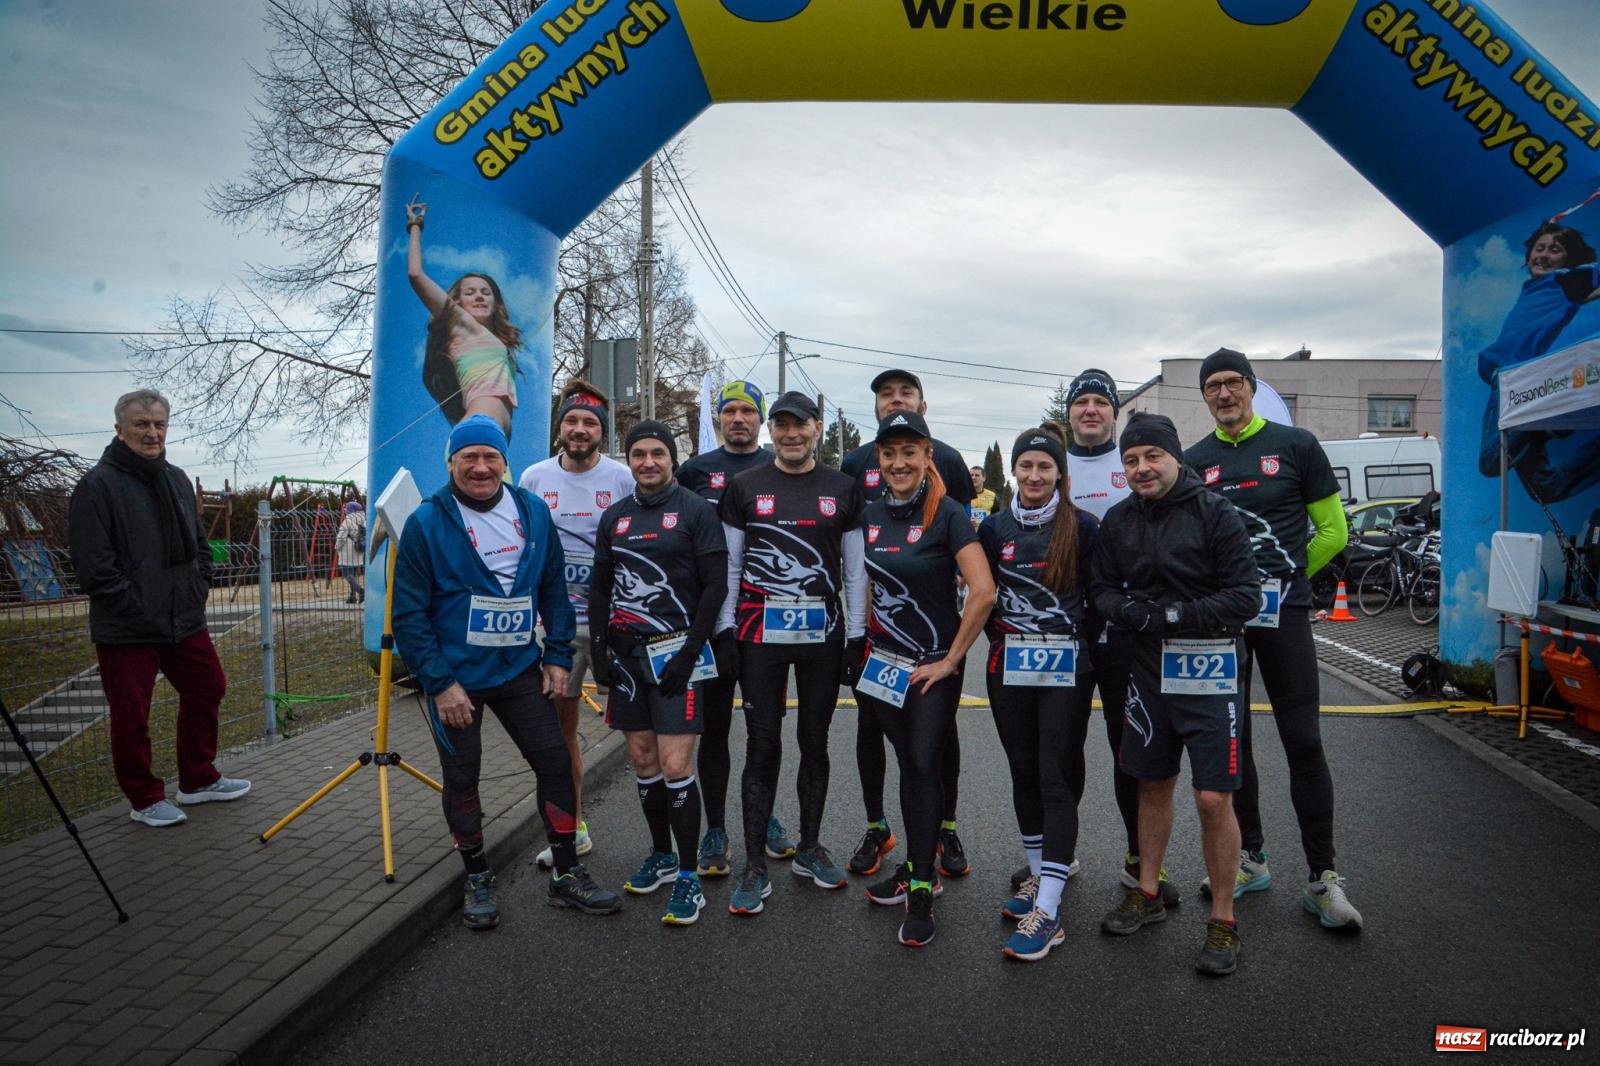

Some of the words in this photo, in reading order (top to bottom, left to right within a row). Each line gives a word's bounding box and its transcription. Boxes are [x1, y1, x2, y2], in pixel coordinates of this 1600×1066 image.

[902, 0, 1128, 31] Wielkie
[434, 42, 547, 144] Gmina
[473, 0, 670, 180] aktywnych
[1363, 1, 1567, 188] aktywnych
[483, 611, 524, 632] 109
[782, 609, 809, 629] 91
[1018, 648, 1064, 671] 197
[1176, 654, 1225, 677] 192
[877, 665, 900, 688] 68
